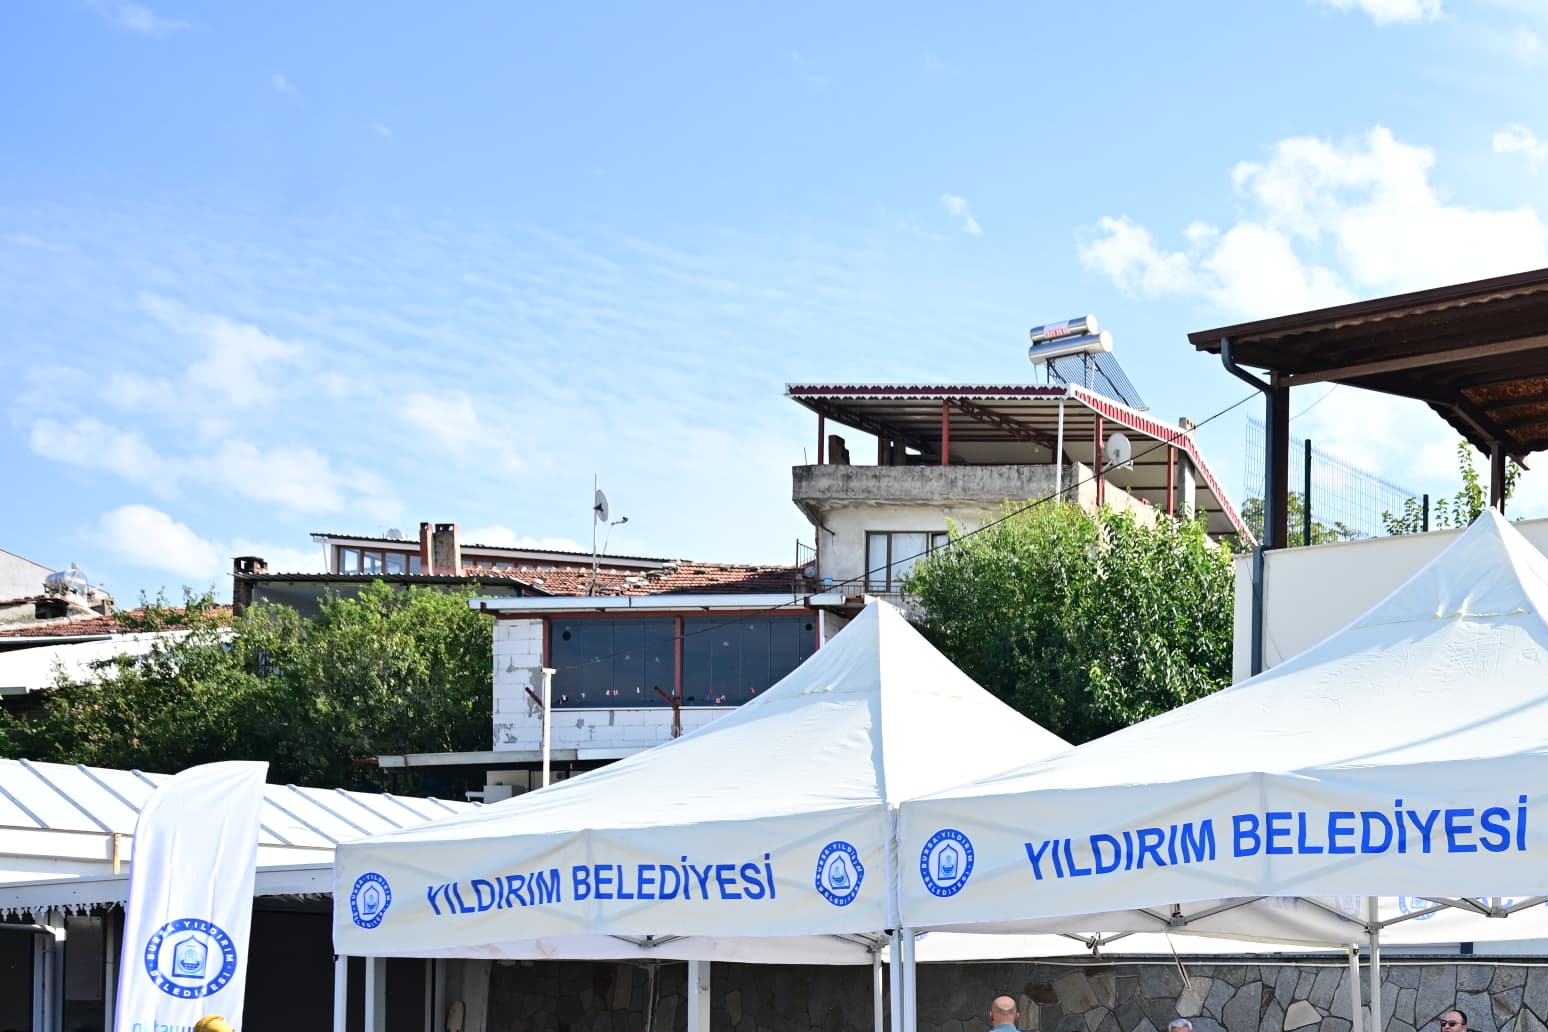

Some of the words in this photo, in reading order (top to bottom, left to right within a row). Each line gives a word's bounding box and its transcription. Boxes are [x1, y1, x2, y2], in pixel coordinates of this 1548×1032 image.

[1024, 818, 1216, 881] YILDIRIM
[1232, 794, 1528, 857] BELEDİYESİ
[426, 868, 562, 916] YILDIRIM
[572, 853, 776, 900] BELEDİYESİ
[183, 920, 234, 962] YILDIRIM
